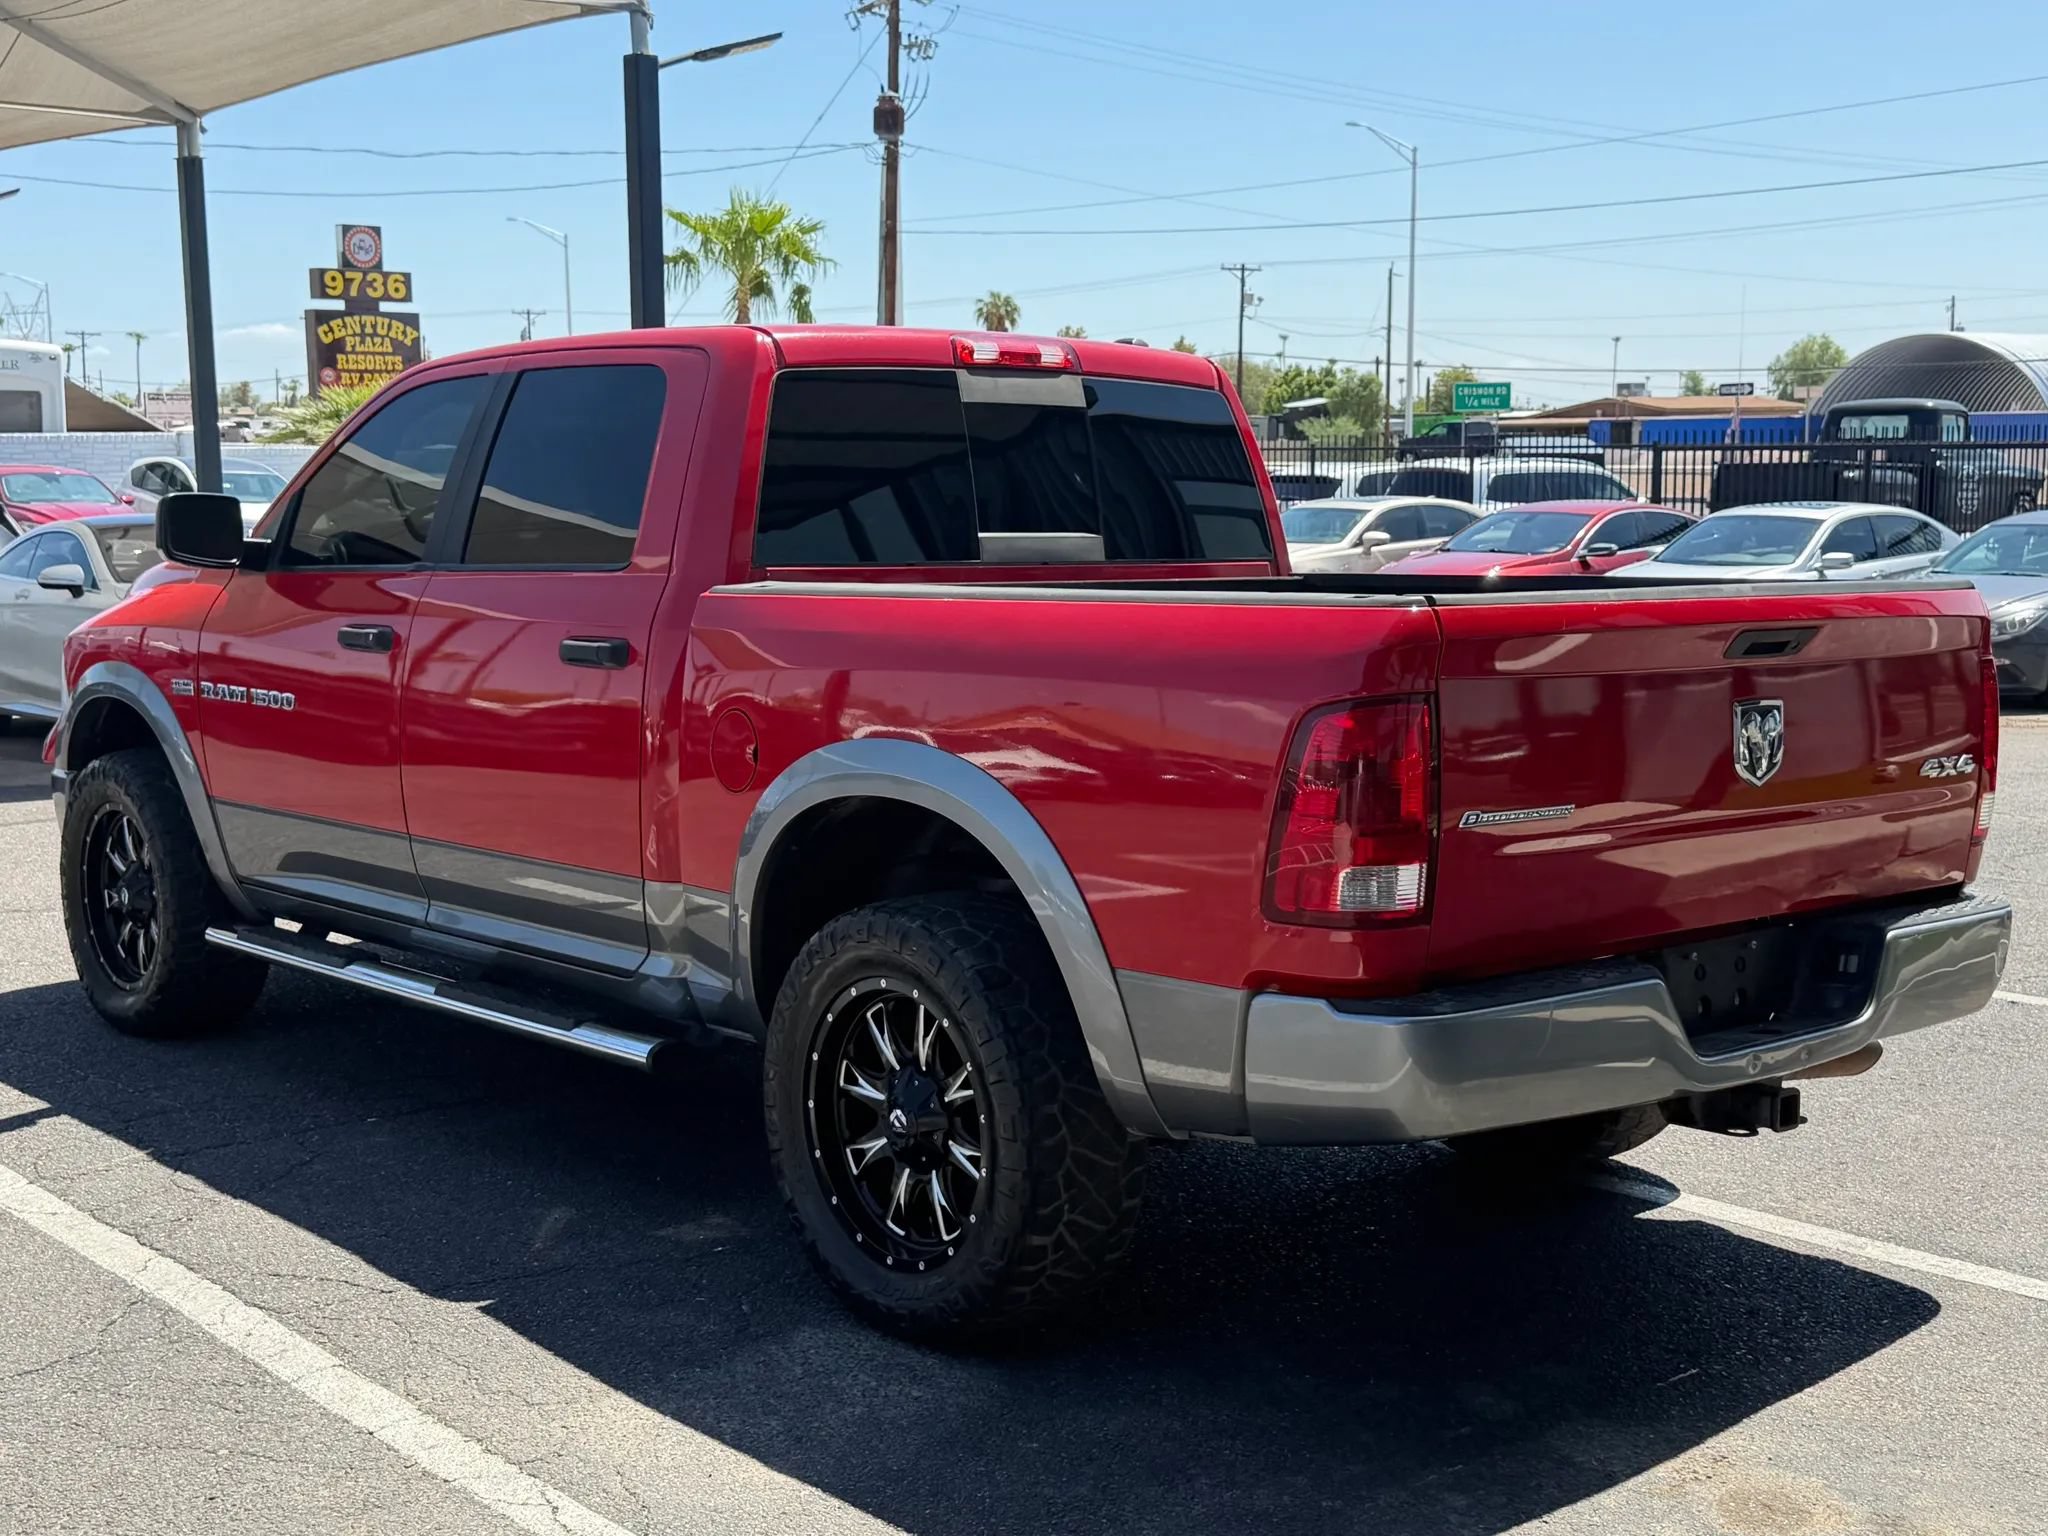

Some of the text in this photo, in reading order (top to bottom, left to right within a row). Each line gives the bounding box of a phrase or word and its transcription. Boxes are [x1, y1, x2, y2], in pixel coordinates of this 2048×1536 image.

[323, 270, 407, 299] 9736
[317, 315, 419, 347] CENTURY
[345, 336, 393, 353] PLAZA
[336, 354, 404, 370] RESORTS
[341, 372, 360, 385] RV
[200, 681, 247, 703] RAM
[251, 688, 295, 711] 1500
